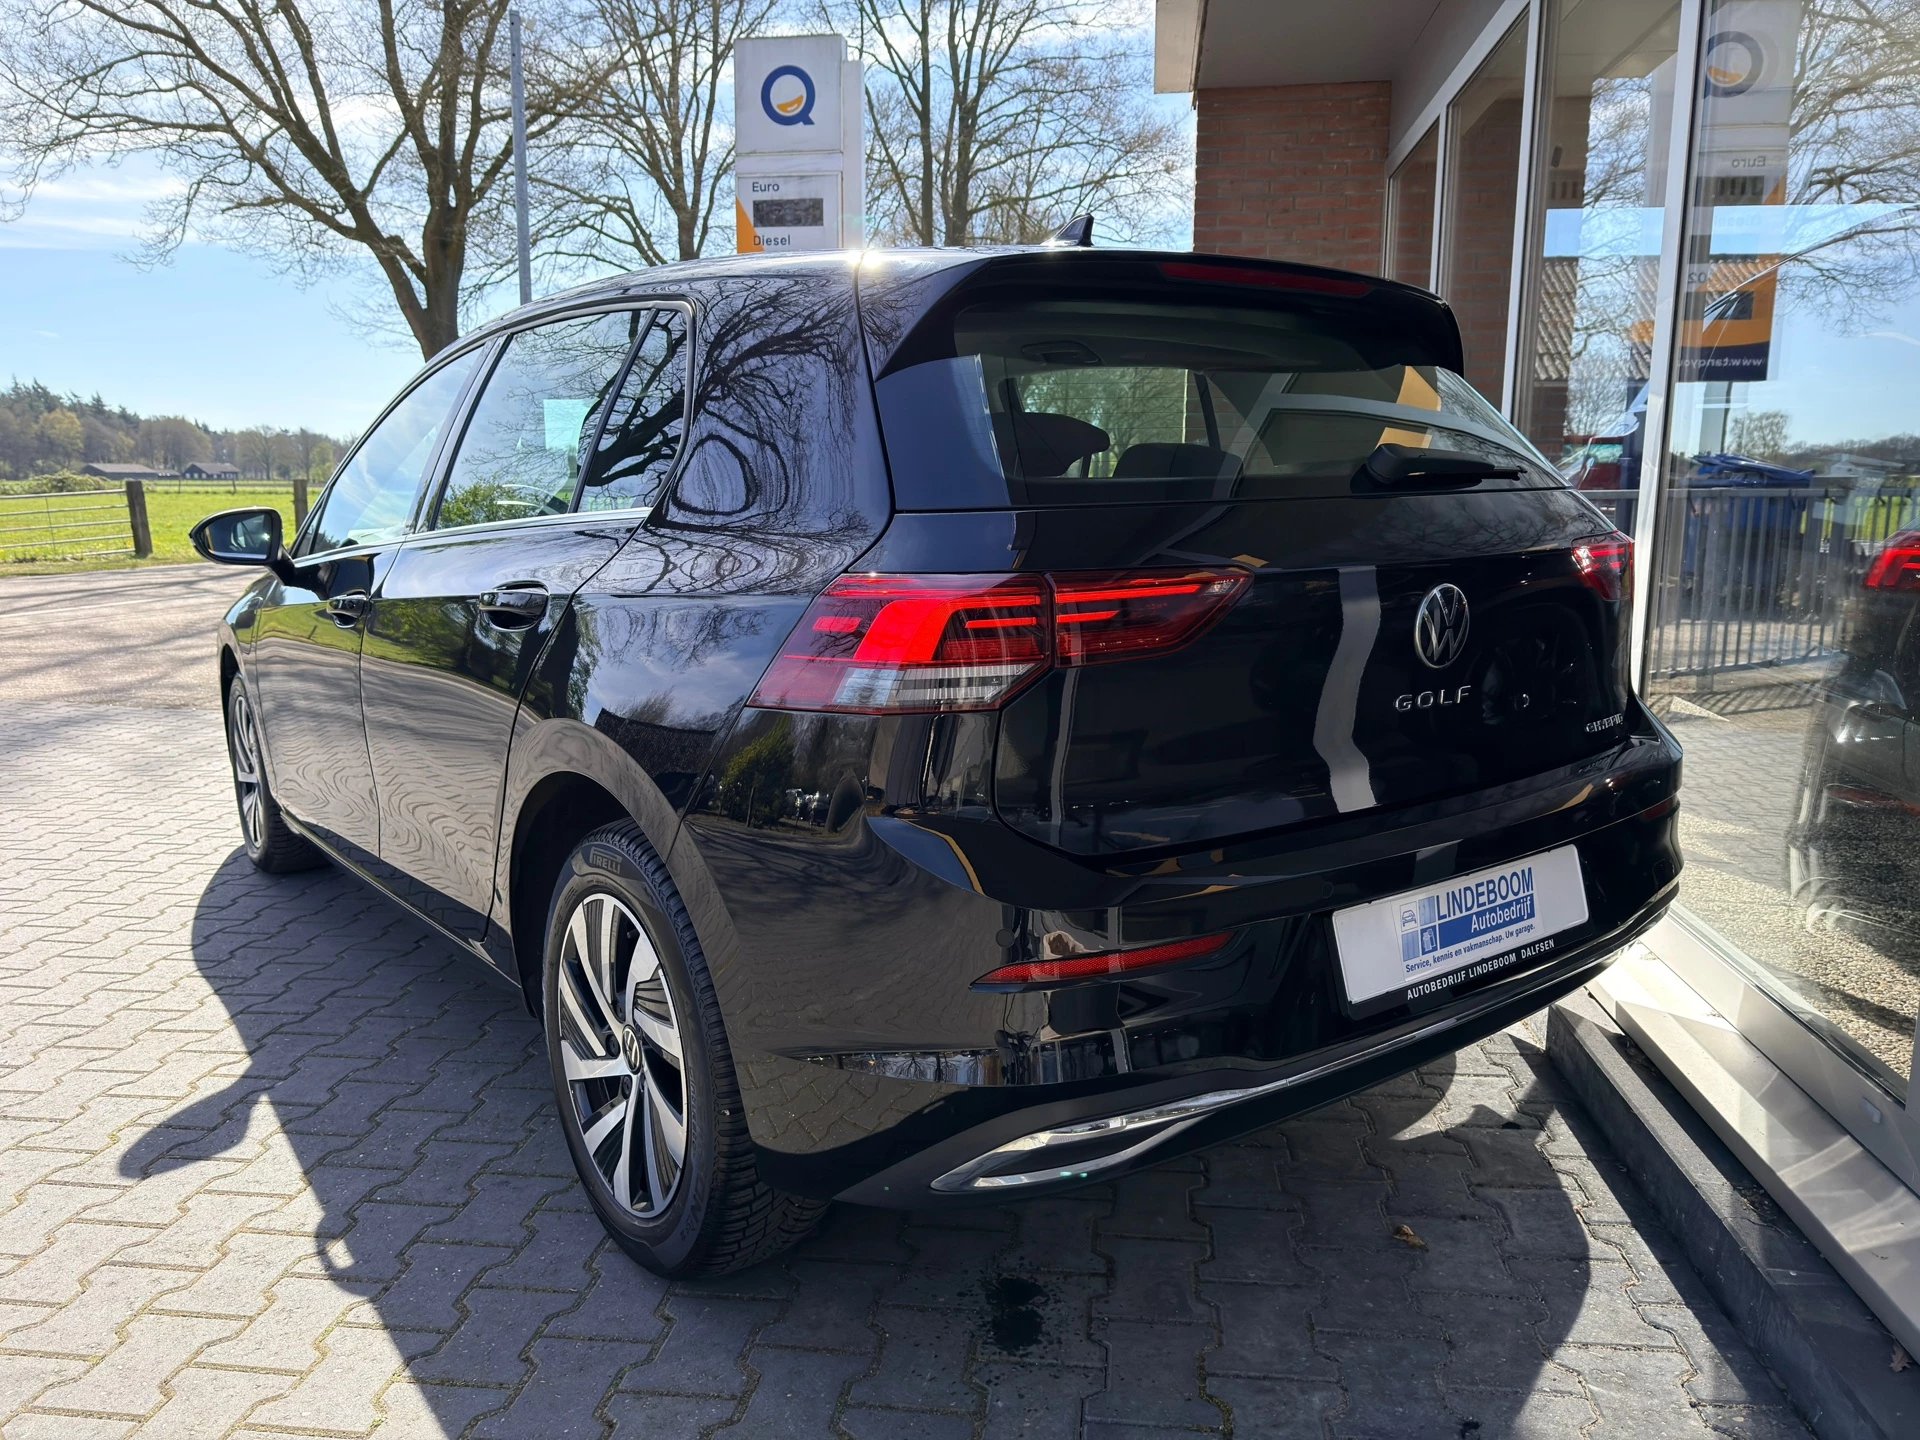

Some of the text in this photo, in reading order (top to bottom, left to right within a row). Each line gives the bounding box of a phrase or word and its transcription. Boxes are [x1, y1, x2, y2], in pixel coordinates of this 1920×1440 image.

[761, 65, 816, 126] Q
[751, 181, 780, 193] Euro
[753, 234, 791, 247] Diesel
[1394, 685, 1471, 712] GOLF
[589, 846, 623, 875] PIRELLI
[1436, 867, 1534, 920] LINDEBOOM
[1471, 896, 1531, 933] Autobedrijf
[1405, 923, 1536, 973] Service, kennis en vakmanschap. Uw garage.
[1406, 938, 1555, 1001] AUTOBEDRIJF LINDEBOOM DALFSEN
